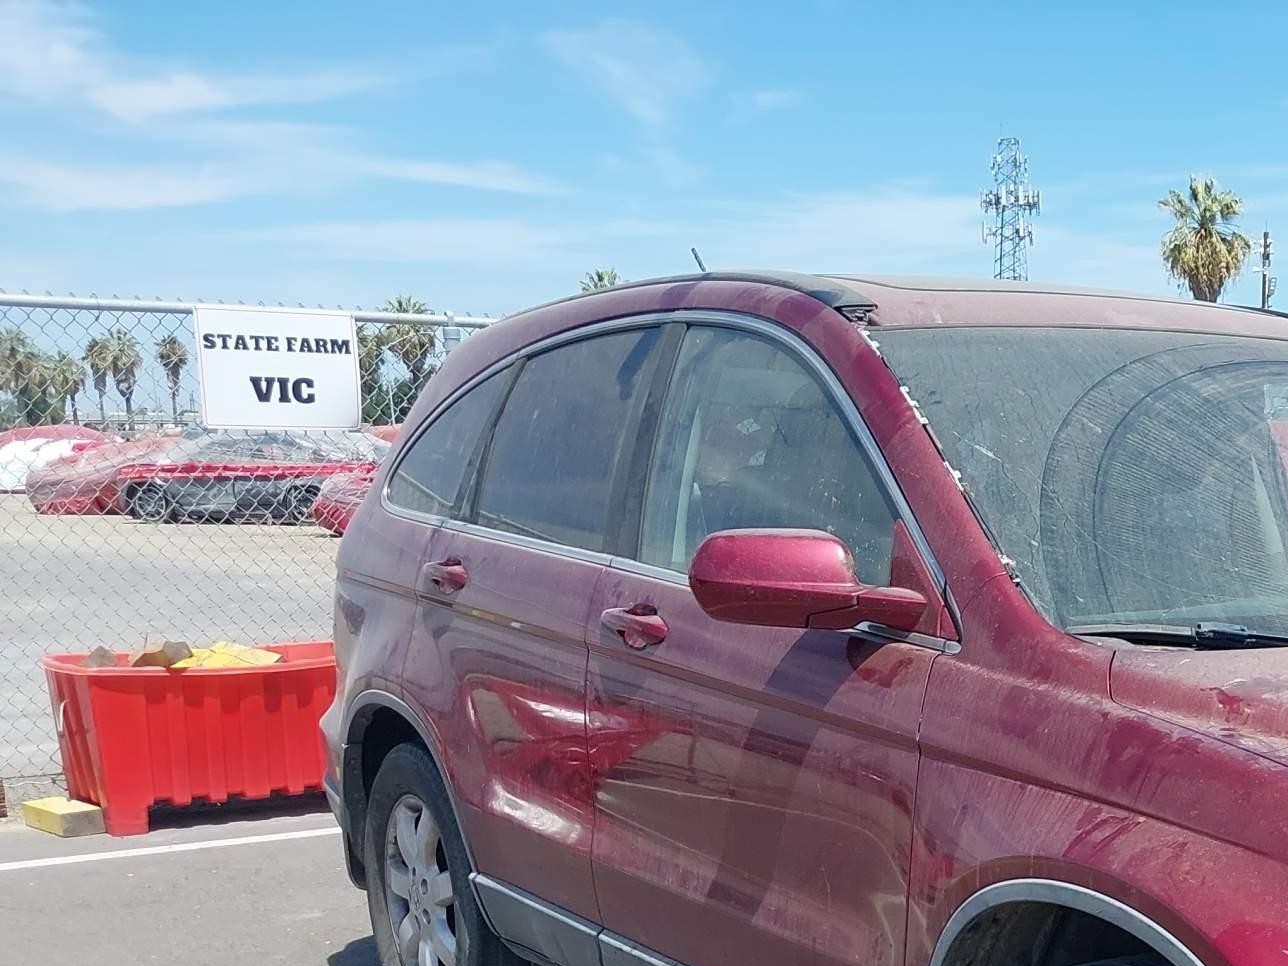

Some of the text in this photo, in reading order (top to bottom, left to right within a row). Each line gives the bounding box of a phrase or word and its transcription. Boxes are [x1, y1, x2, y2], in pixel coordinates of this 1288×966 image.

[203, 333, 352, 354] STATE FARM
[249, 376, 316, 404] VIC
